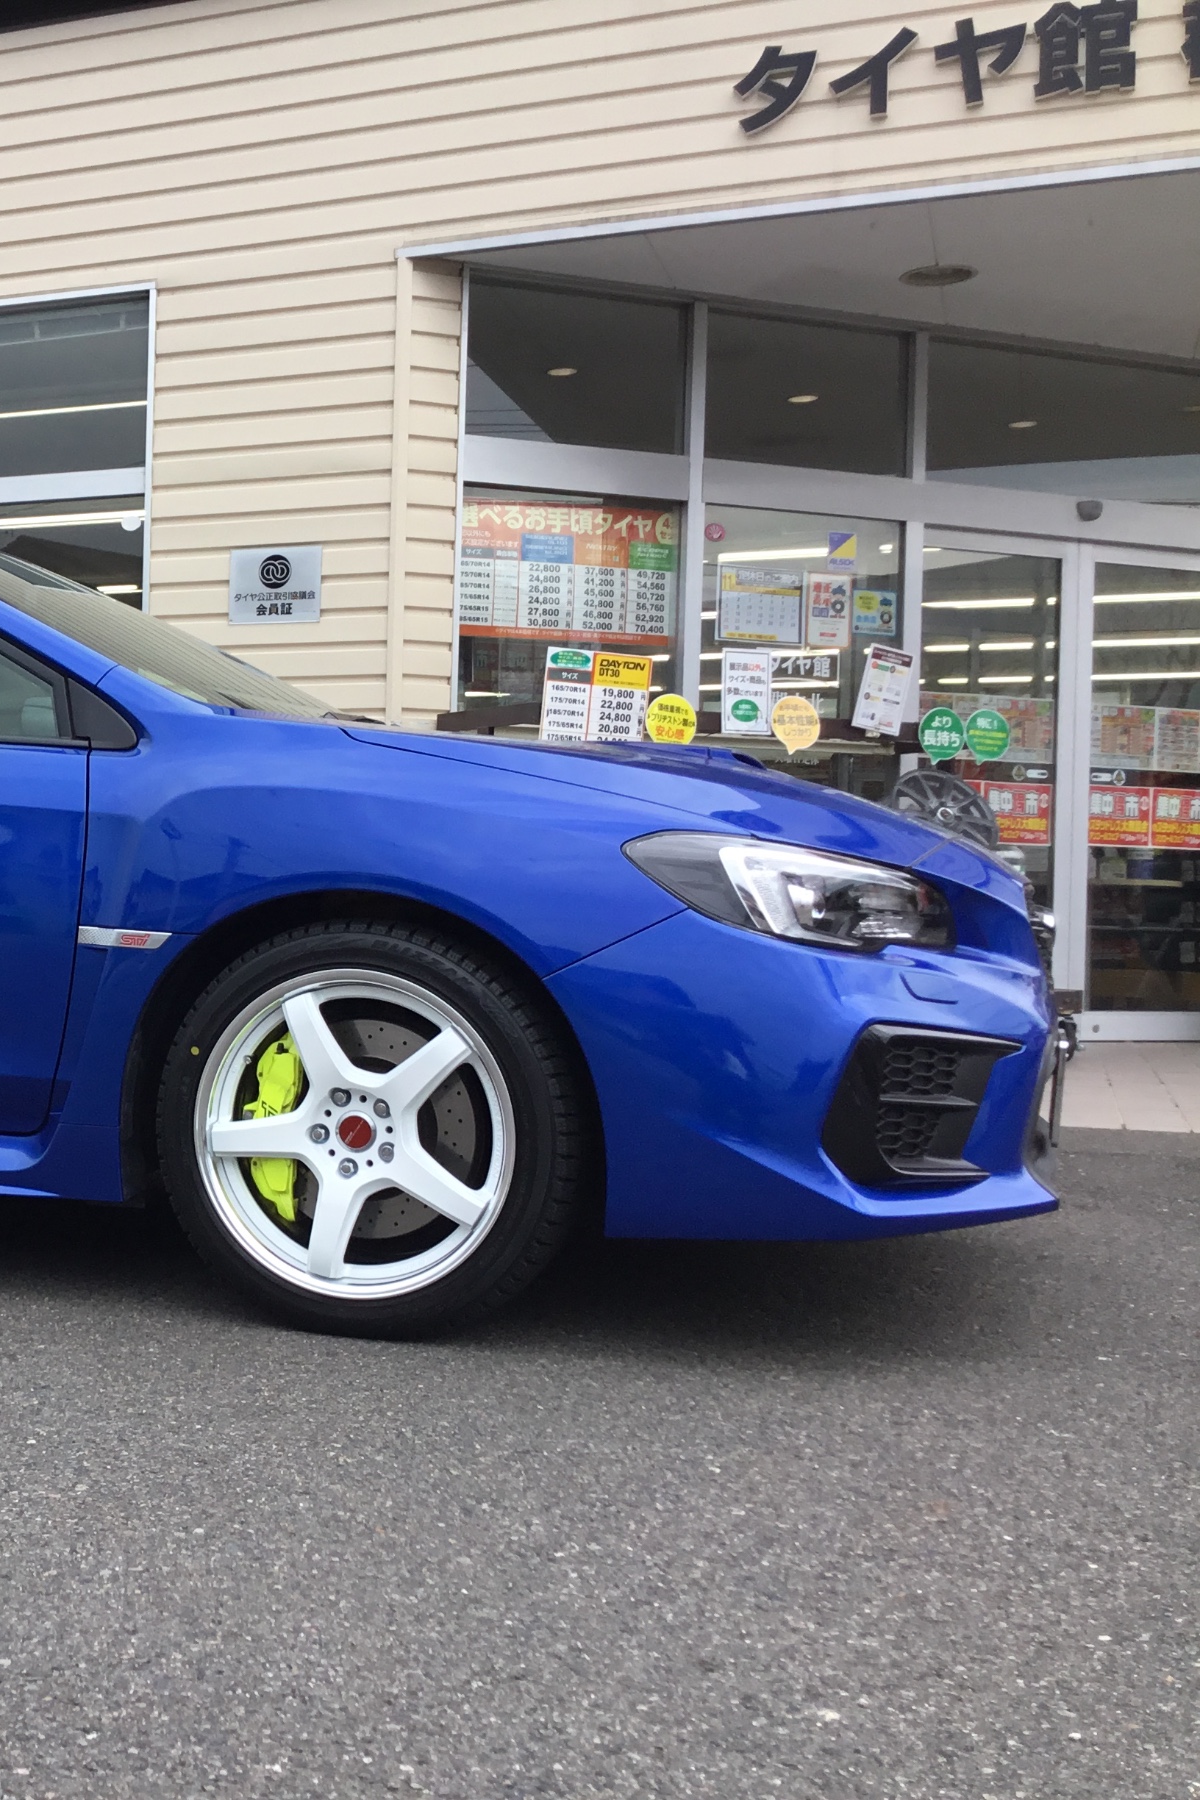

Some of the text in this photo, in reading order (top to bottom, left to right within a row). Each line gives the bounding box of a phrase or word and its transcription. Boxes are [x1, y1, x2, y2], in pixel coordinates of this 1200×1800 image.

[733, 0, 1138, 137] タイヤ館
[529, 564, 561, 573] 22,800
[585, 567, 615, 577] 37,600
[637, 571, 666, 581] 49,720
[528, 574, 561, 584] 24,800
[584, 578, 615, 587] 41,200
[637, 581, 665, 591] 54,560
[234, 590, 316, 602] タイヤ公正取引協議会
[528, 585, 560, 595] 26,800
[584, 588, 615, 598] 45,600
[636, 592, 665, 602] 60,720
[256, 603, 293, 616] 会員証
[528, 596, 560, 606] 24,800
[583, 599, 614, 609] 42,800
[636, 603, 665, 613] 56,760
[527, 607, 560, 617] 27,800
[582, 610, 613, 620] 46,800
[635, 614, 664, 624] 62,920
[527, 618, 559, 628] 30,800
[582, 621, 612, 631] 52,000
[635, 624, 664, 634] 70,400
[598, 668, 620, 678] DT30
[599, 659, 646, 672] DAYTON
[561, 671, 579, 680] サイズ
[551, 684, 587, 694] 165/70R14
[601, 687, 635, 699] 19,800
[550, 696, 585, 705] 175/70R14
[600, 699, 633, 711] 22,800
[549, 708, 632, 723] 185/70R14 24,800
[931, 715, 953, 728] より
[548, 720, 583, 730] 175/65R14
[597, 723, 630, 735] 20,800
[655, 725, 685, 740] 安心感
[783, 728, 812, 737] しっかり
[923, 729, 961, 748] 長持ち
